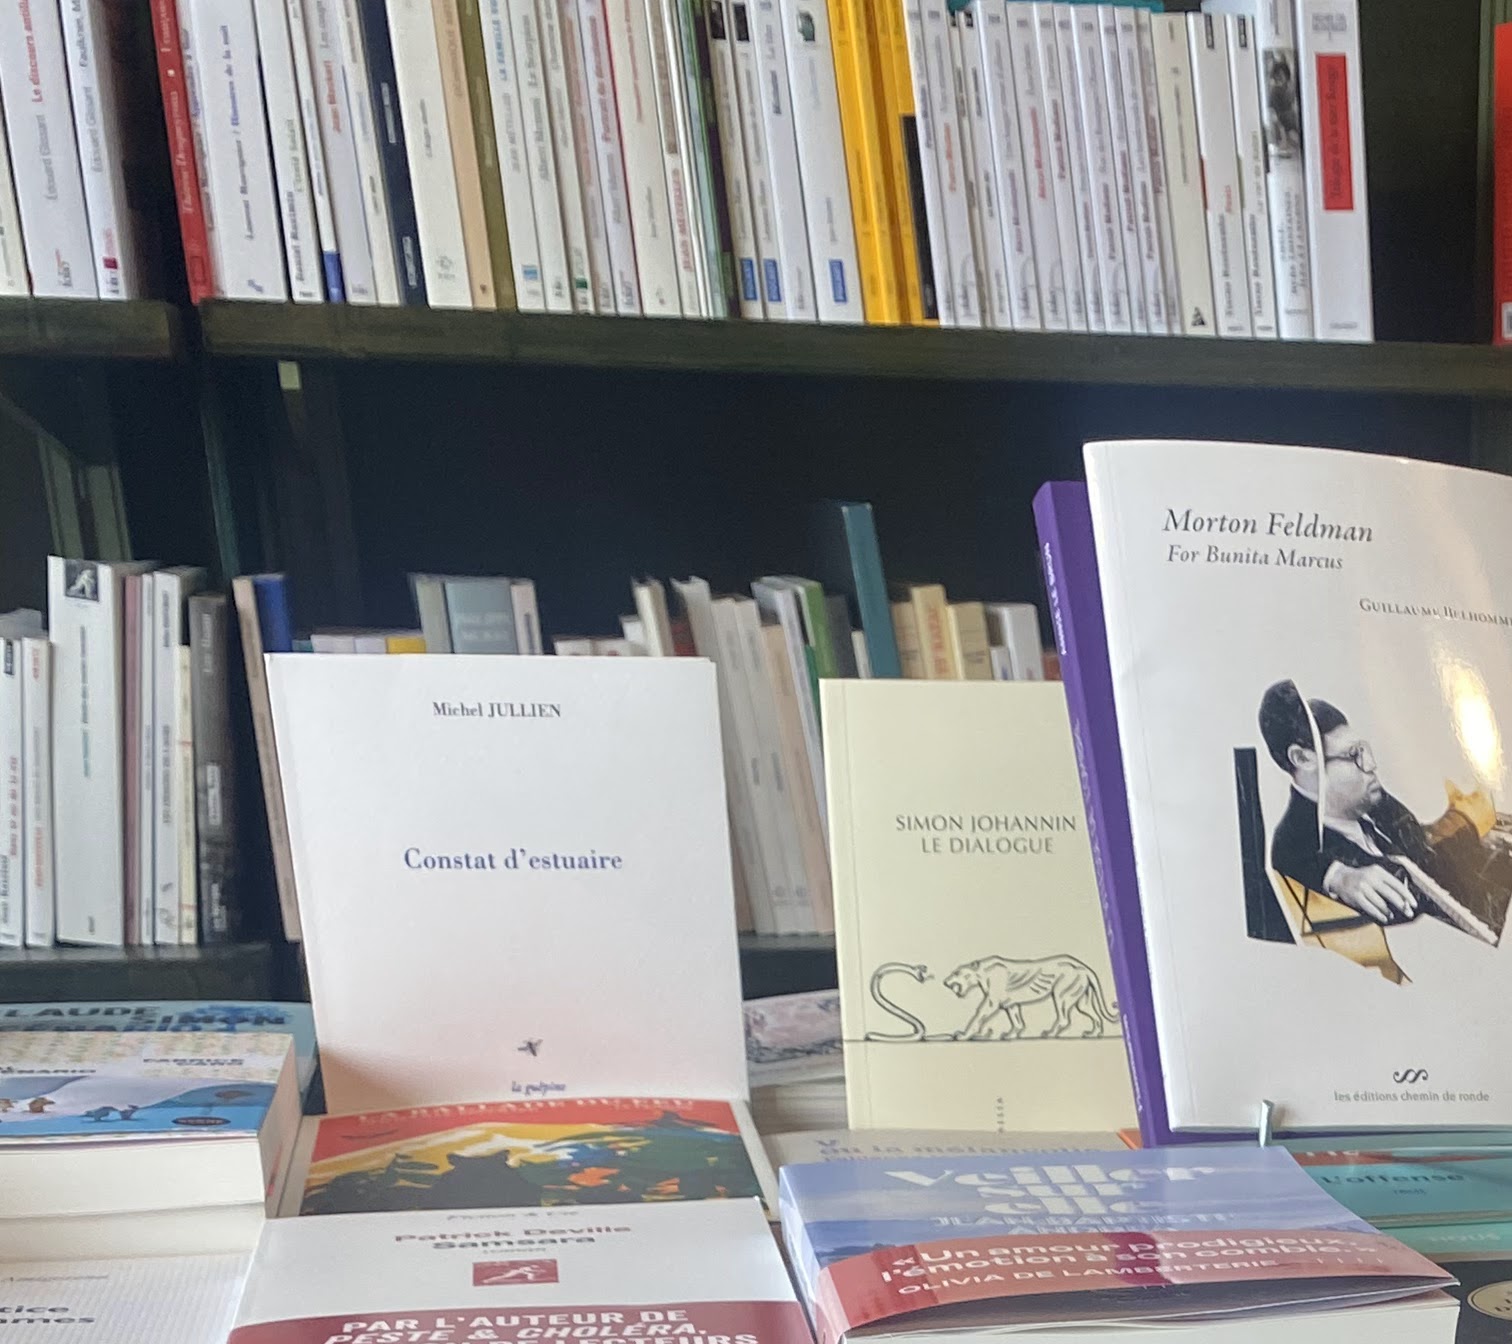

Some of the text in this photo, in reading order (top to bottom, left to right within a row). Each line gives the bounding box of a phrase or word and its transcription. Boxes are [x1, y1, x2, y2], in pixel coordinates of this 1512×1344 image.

[1162, 508, 1374, 542] Morton Feldman
[1166, 544, 1344, 570] For Bunita Marcus
[432, 701, 562, 718] Michel JULLIEN
[896, 814, 1076, 833] SIMON JOHANNIN
[921, 837, 1054, 855] LE DIALOGUE
[403, 847, 624, 870] Constat d'estuaire
[3, 1006, 160, 1017] LAUDE
[1334, 1090, 1490, 1102] les éditions chemin de ronde
[885, 1164, 1216, 1188] Veiller
[983, 1196, 1160, 1217] elle
[394, 1223, 632, 1243] Patrick Deville
[432, 1234, 597, 1251] Samsara
[982, 1242, 1112, 1259] amour
[881, 1249, 1174, 1283] l'émotion à son
[897, 1259, 1282, 1296] OLIVIA DE LAMBERTERIE
[342, 1309, 687, 1334] PAR L'AUTEUR DE
[467, 1326, 500, 1341] &
